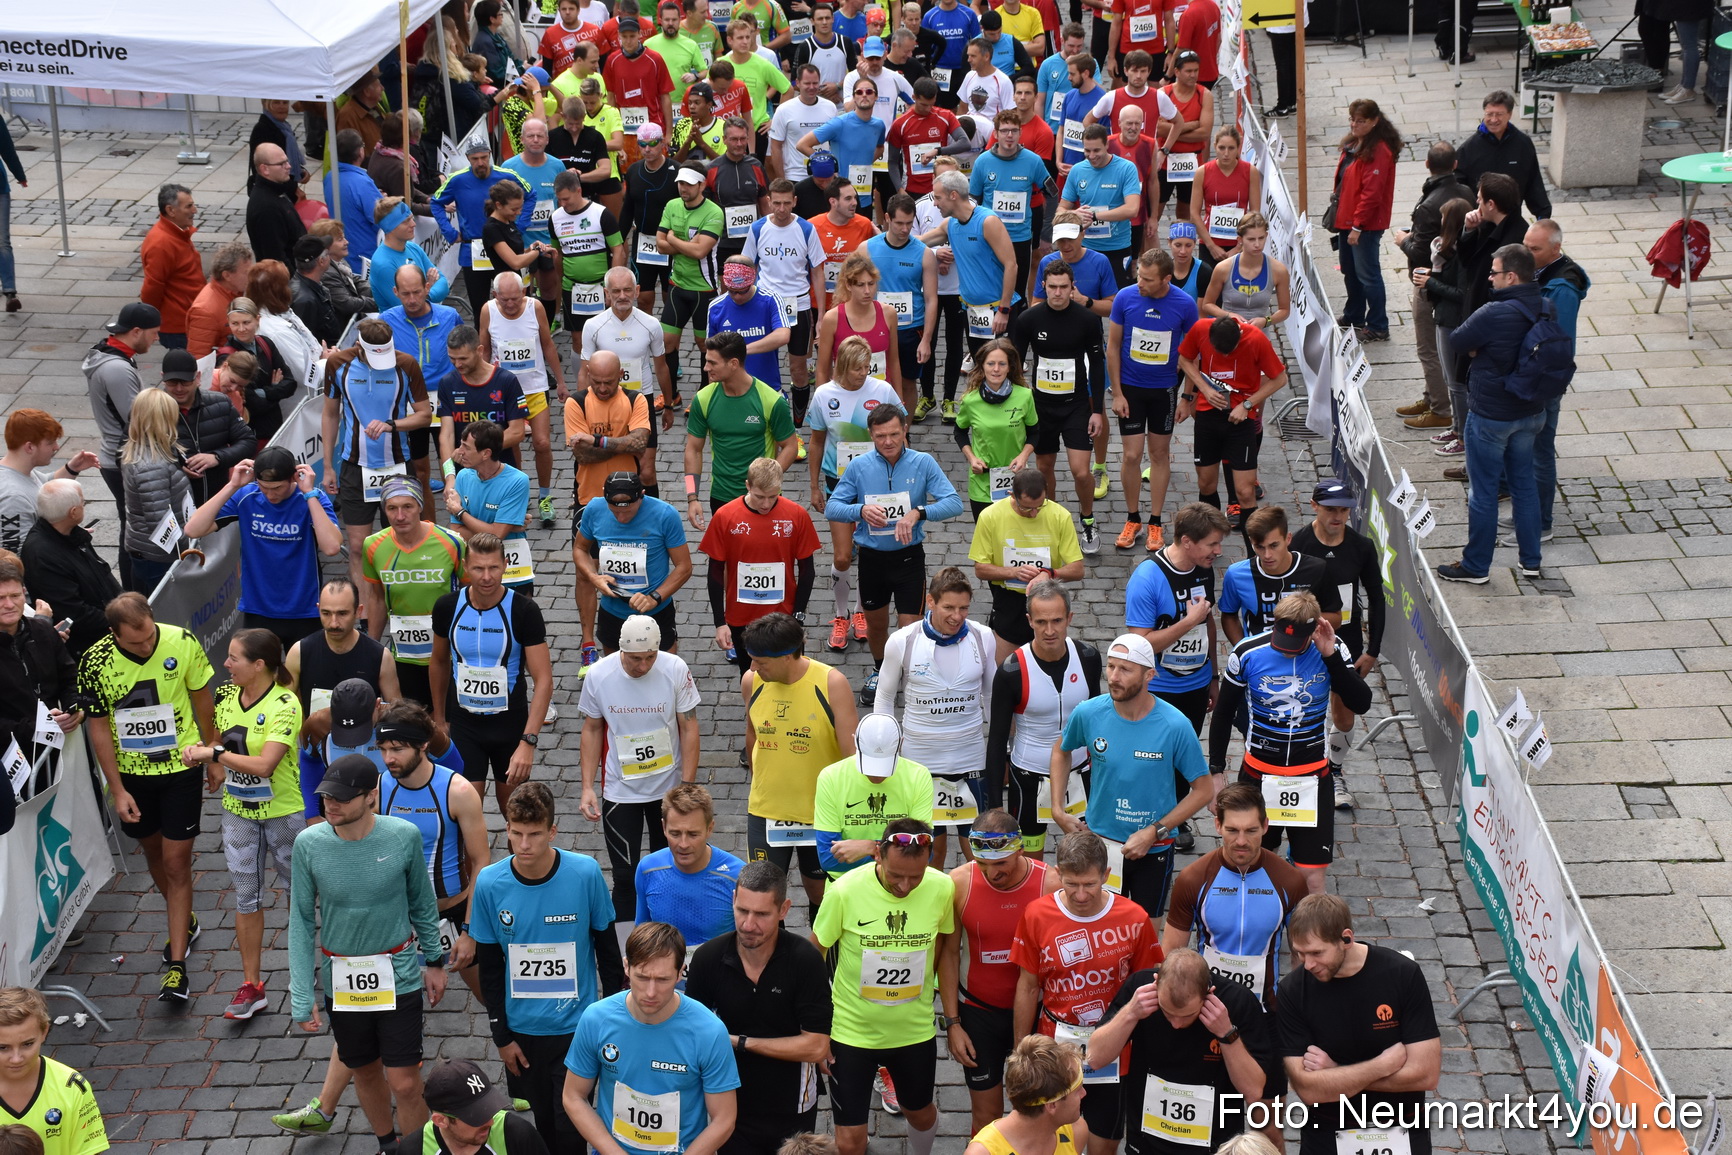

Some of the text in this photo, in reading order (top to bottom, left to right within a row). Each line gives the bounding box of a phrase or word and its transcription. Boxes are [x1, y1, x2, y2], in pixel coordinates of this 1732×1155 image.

[1134, 22, 1153, 33] 2469
[16, 62, 34, 73] zu
[38, 61, 75, 75] sein.
[625, 115, 645, 125] 2315
[1171, 162, 1194, 172] 2098
[857, 174, 866, 184] 97
[997, 200, 1021, 211] 2164
[731, 215, 754, 227] 2999
[575, 291, 600, 304] 2776
[1139, 340, 1161, 352] 227
[504, 348, 531, 361] 2182
[1044, 369, 1065, 382] 151
[452, 410, 506, 423] MENSCH
[252, 519, 300, 535] SYSCAD
[1414, 510, 1433, 531] swn
[159, 525, 173, 545] swn
[606, 559, 637, 574] 2381
[380, 569, 445, 585] BOCK
[744, 575, 776, 589] 2301
[396, 629, 430, 643] 2785
[1171, 639, 1202, 653] 2541
[463, 678, 500, 695] 2706
[608, 702, 667, 716] Kaiserwinkl
[930, 705, 966, 715] ULMER
[124, 719, 167, 736] 2690
[635, 745, 656, 762] 56
[1134, 750, 1163, 759] BOCK
[1527, 736, 1546, 761] swn
[8, 758, 22, 780] wn
[937, 791, 964, 808] 218
[1116, 798, 1132, 810] 18.
[1279, 791, 1300, 807] 89
[1115, 807, 1151, 816] Neumarkter
[786, 830, 804, 838] Alfred
[544, 914, 577, 923] BOCK
[519, 959, 567, 977] 2735
[346, 972, 379, 990] 169
[876, 968, 911, 985] 222
[349, 994, 378, 1002] Christian
[886, 990, 899, 998] Udo
[651, 1060, 687, 1073] BOCK
[1159, 1099, 1196, 1122] 136
[627, 1106, 663, 1130] 109
[1160, 1121, 1192, 1134] Christian
[634, 1130, 652, 1141] Toms
